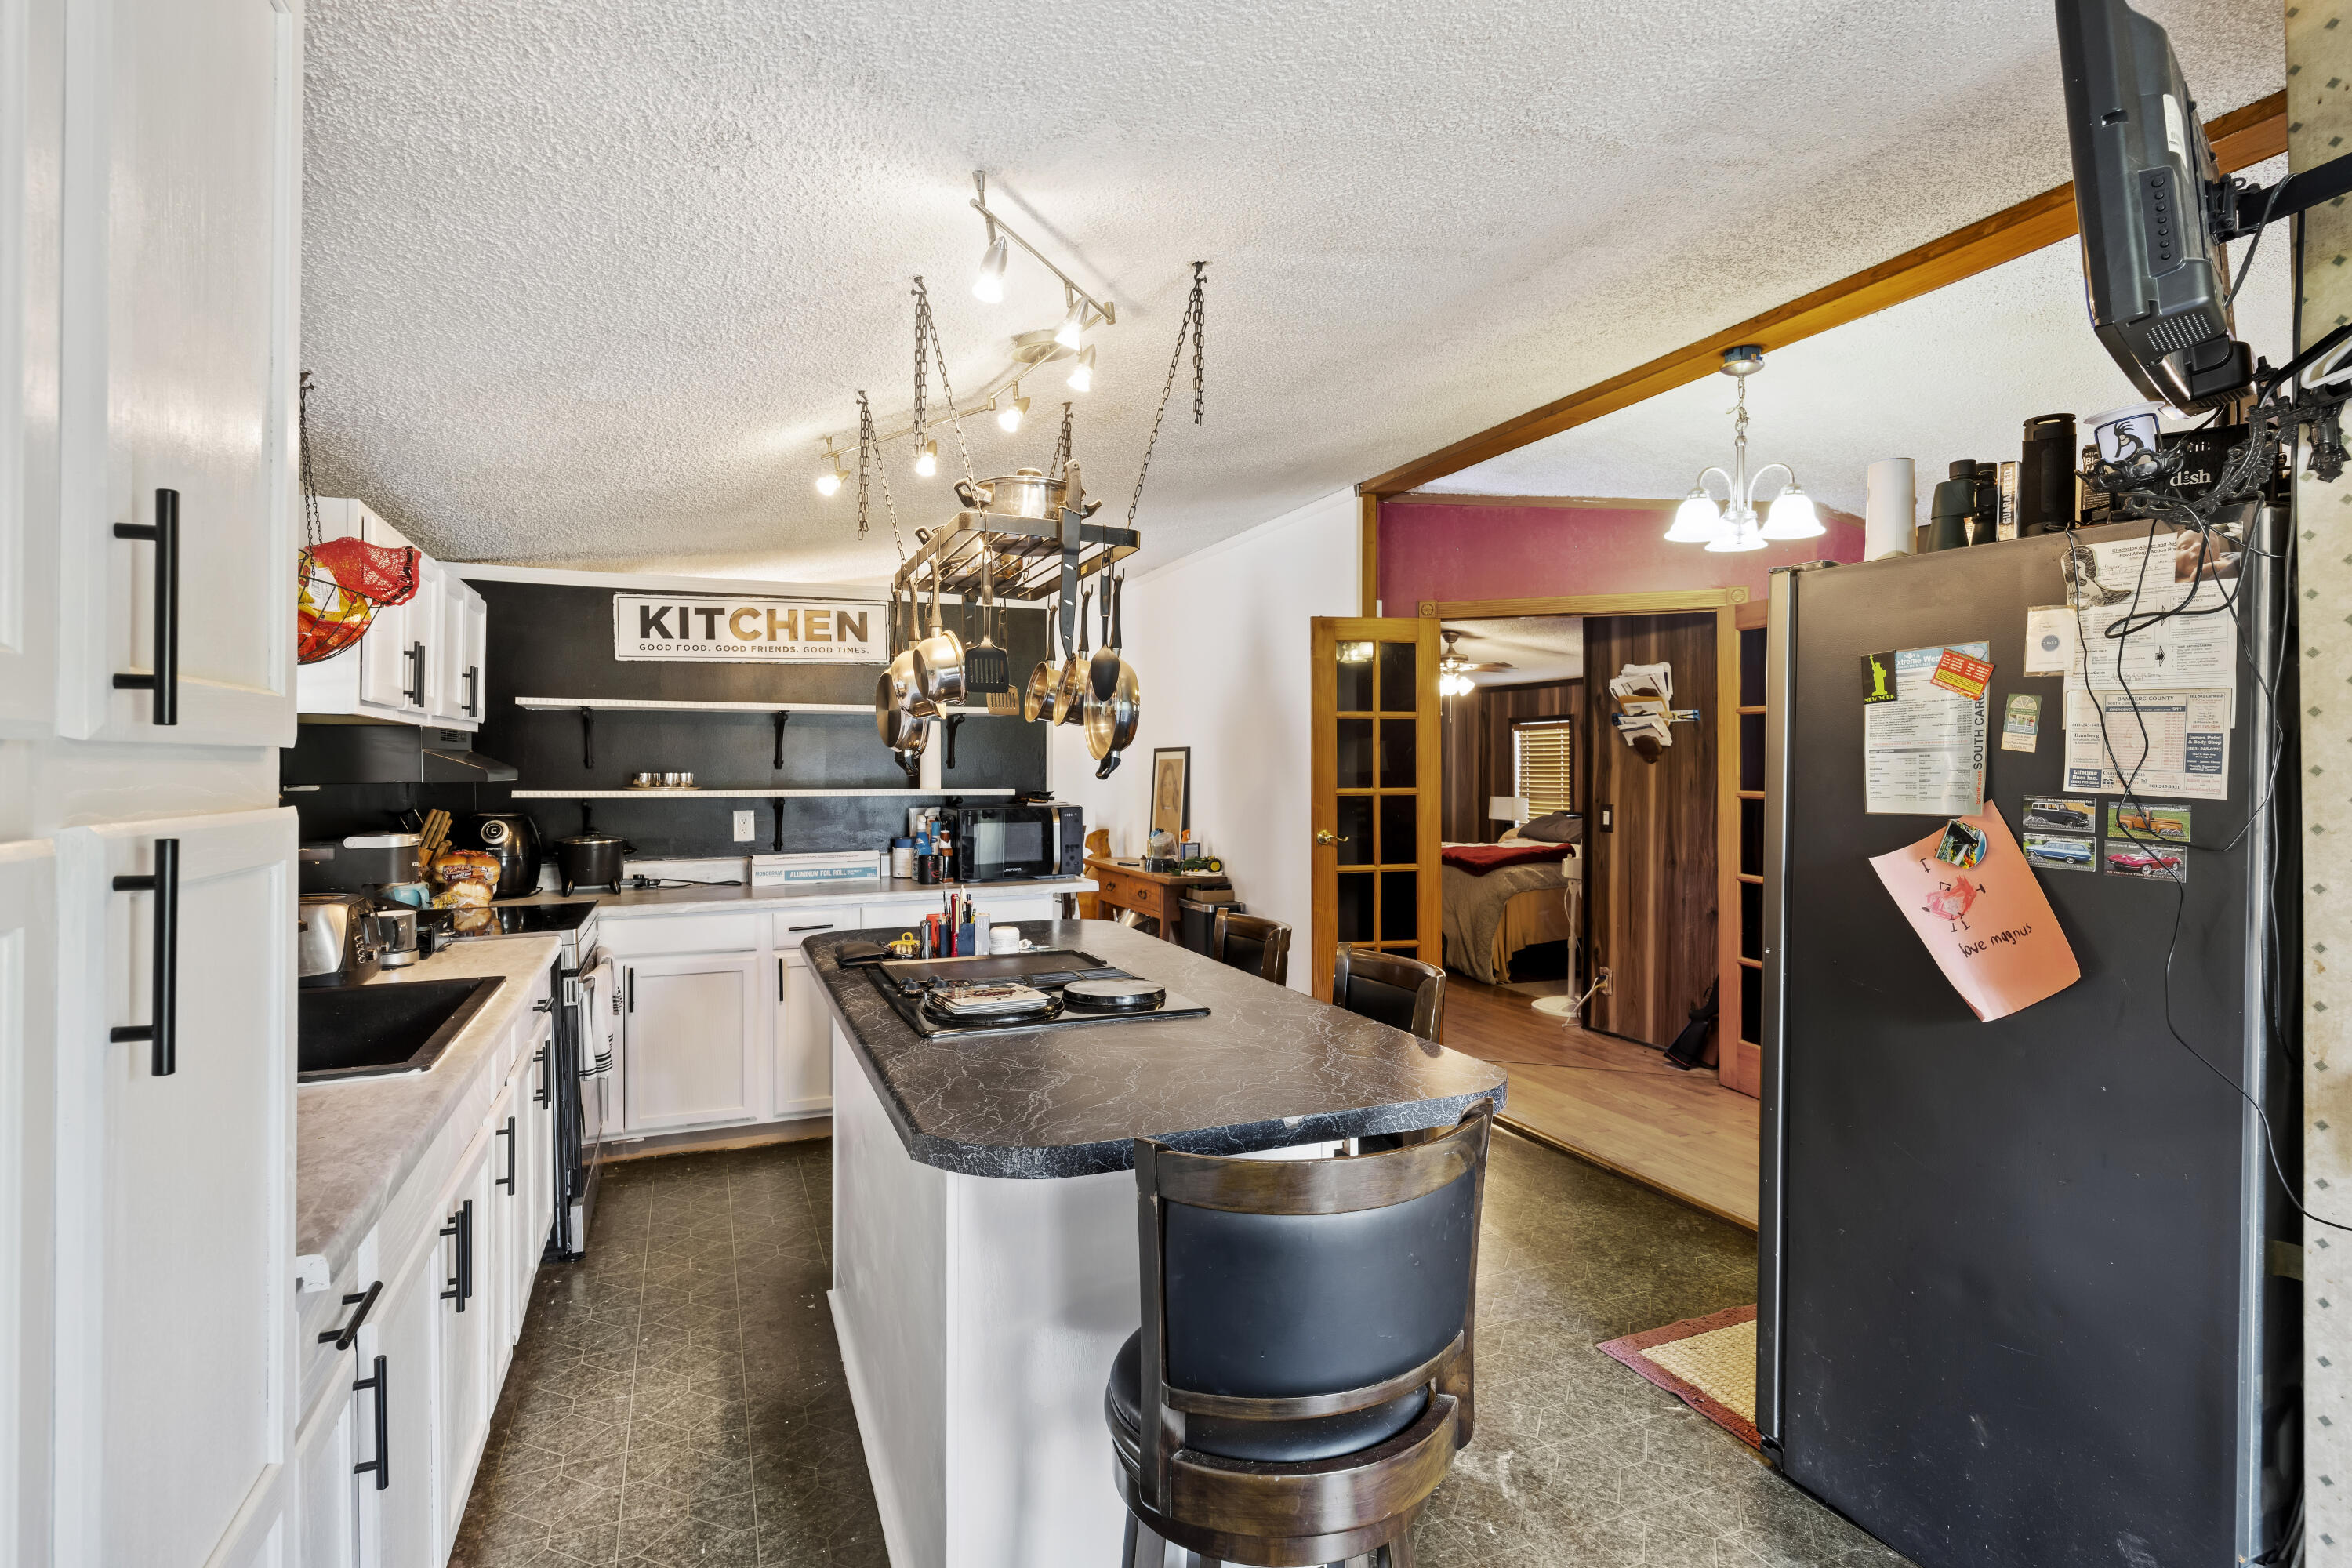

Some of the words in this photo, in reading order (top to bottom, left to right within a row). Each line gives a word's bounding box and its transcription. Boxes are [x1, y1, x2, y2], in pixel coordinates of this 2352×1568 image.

[2169, 469, 2212, 486] dish
[2002, 470, 2013, 524] GUARANTEED
[639, 605, 868, 642] KITCHEN
[1973, 729, 1984, 770] SOUTH
[1958, 940, 1987, 958] love
[1991, 923, 2032, 945] magnus
